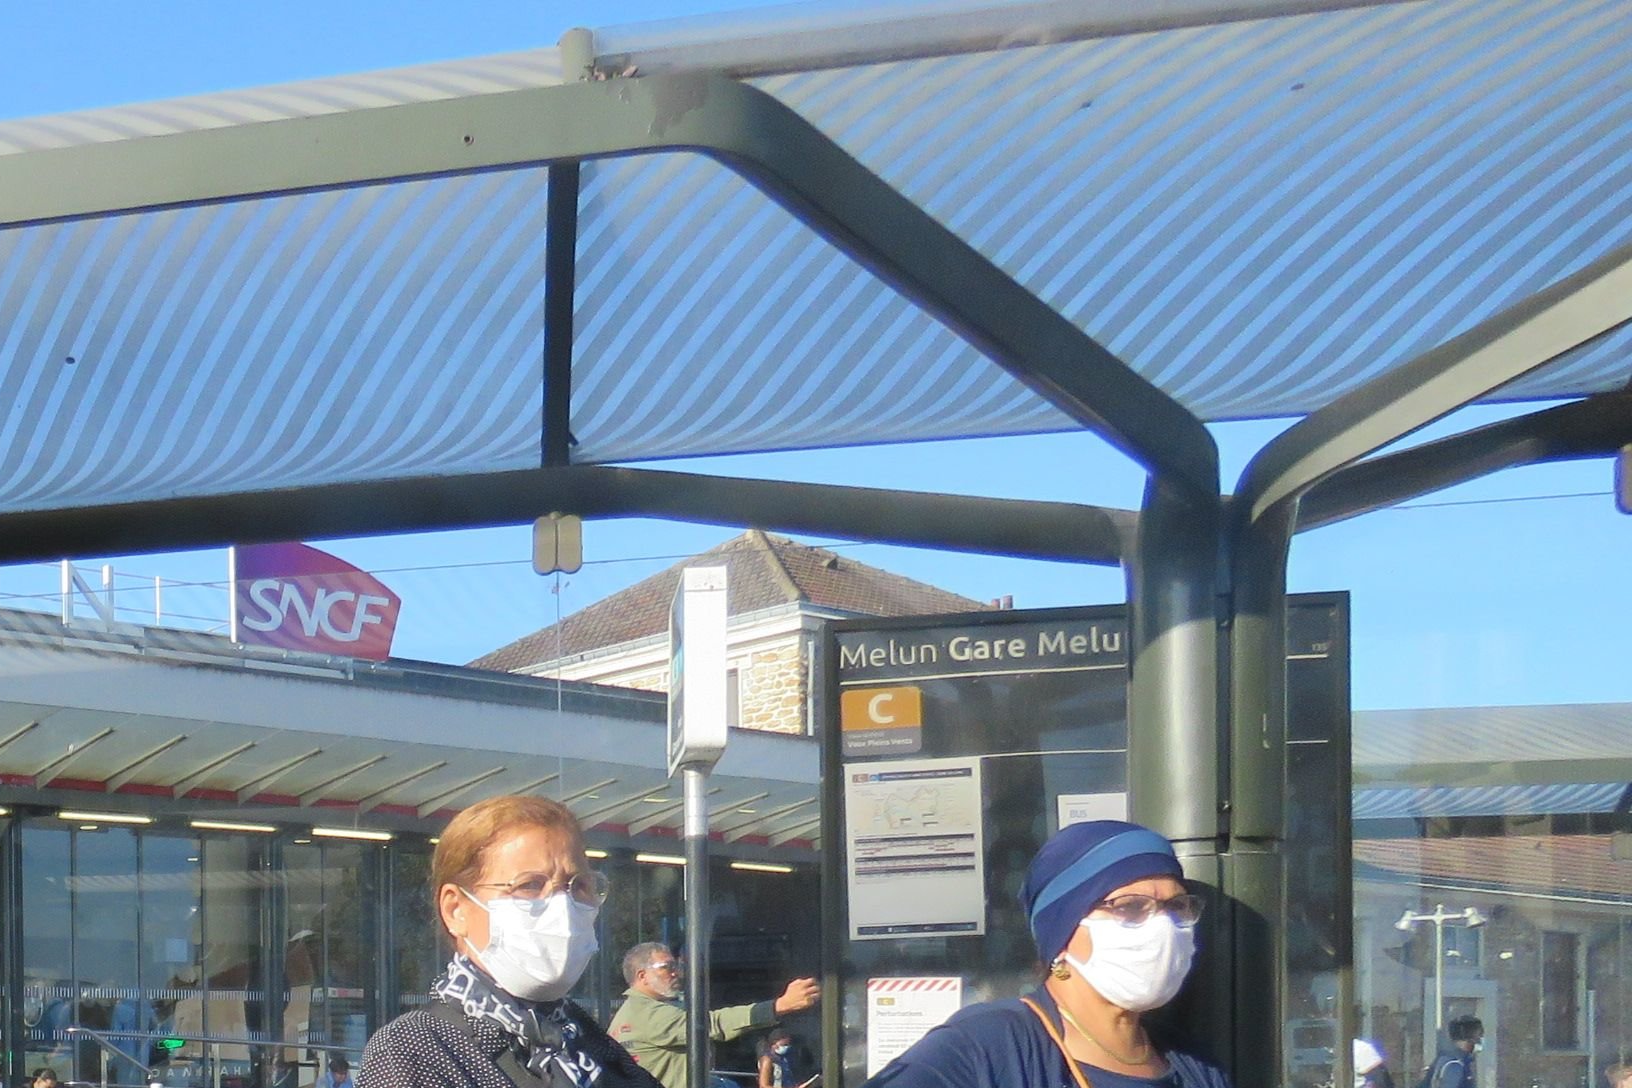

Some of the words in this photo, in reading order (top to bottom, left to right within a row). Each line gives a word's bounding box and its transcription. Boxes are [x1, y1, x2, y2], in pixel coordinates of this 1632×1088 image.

[243, 577, 389, 642] SNCF
[840, 639, 937, 669] Melun
[948, 636, 1026, 662] Gare
[1038, 626, 1128, 657] Melu
[868, 693, 895, 724] C
